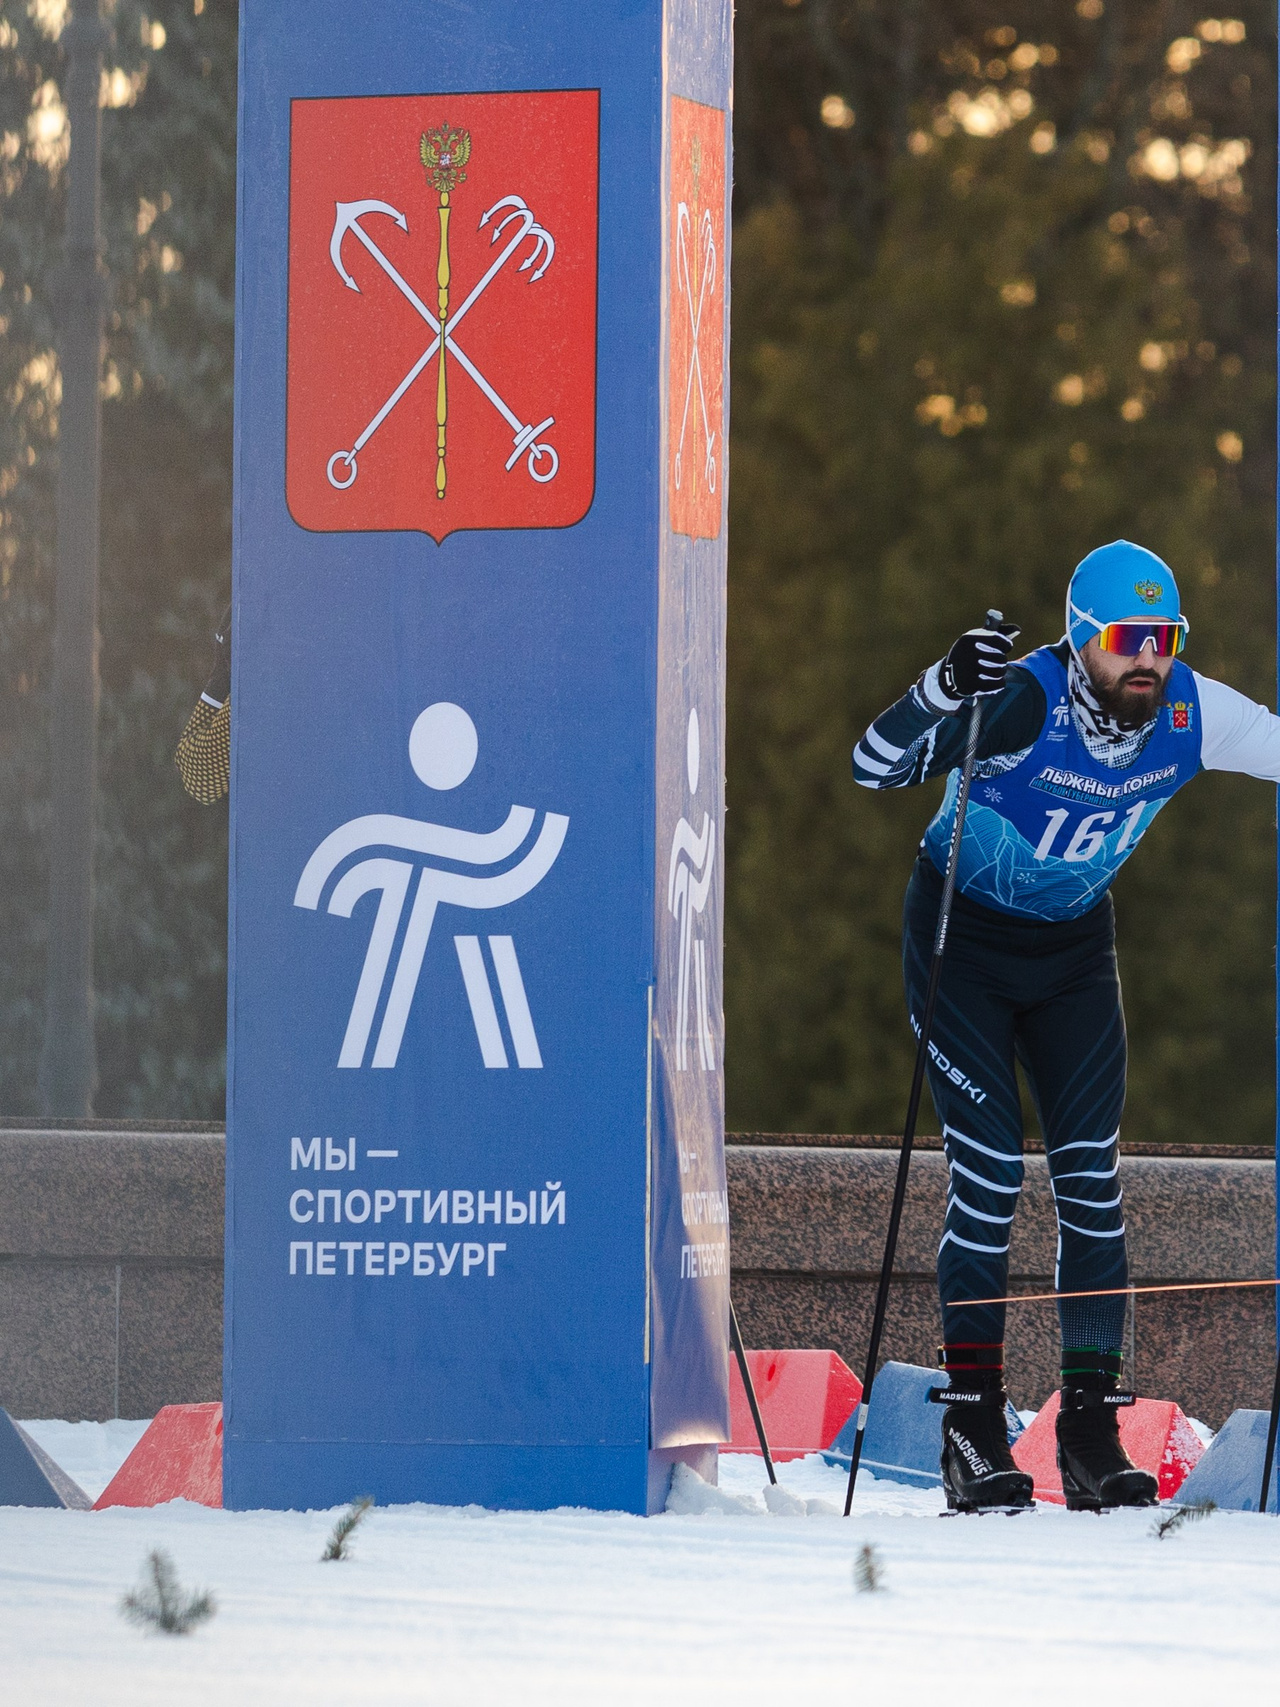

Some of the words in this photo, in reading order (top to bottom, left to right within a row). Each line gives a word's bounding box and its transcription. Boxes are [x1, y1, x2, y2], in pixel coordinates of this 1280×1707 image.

[1040, 767, 1122, 798] ЛЫЖНЫЕ
[1123, 766, 1176, 794] ГОНКИ
[1033, 800, 1147, 863] 161
[938, 914, 949, 949] NORDWAY
[290, 1137, 356, 1171] МЫ
[289, 1180, 566, 1225] СПОРТИВНЫЙ
[289, 1241, 507, 1277] ПЕТЕРБУРГ
[940, 1392, 982, 1402] MADSHUS
[948, 1427, 988, 1477] MADSHUS
